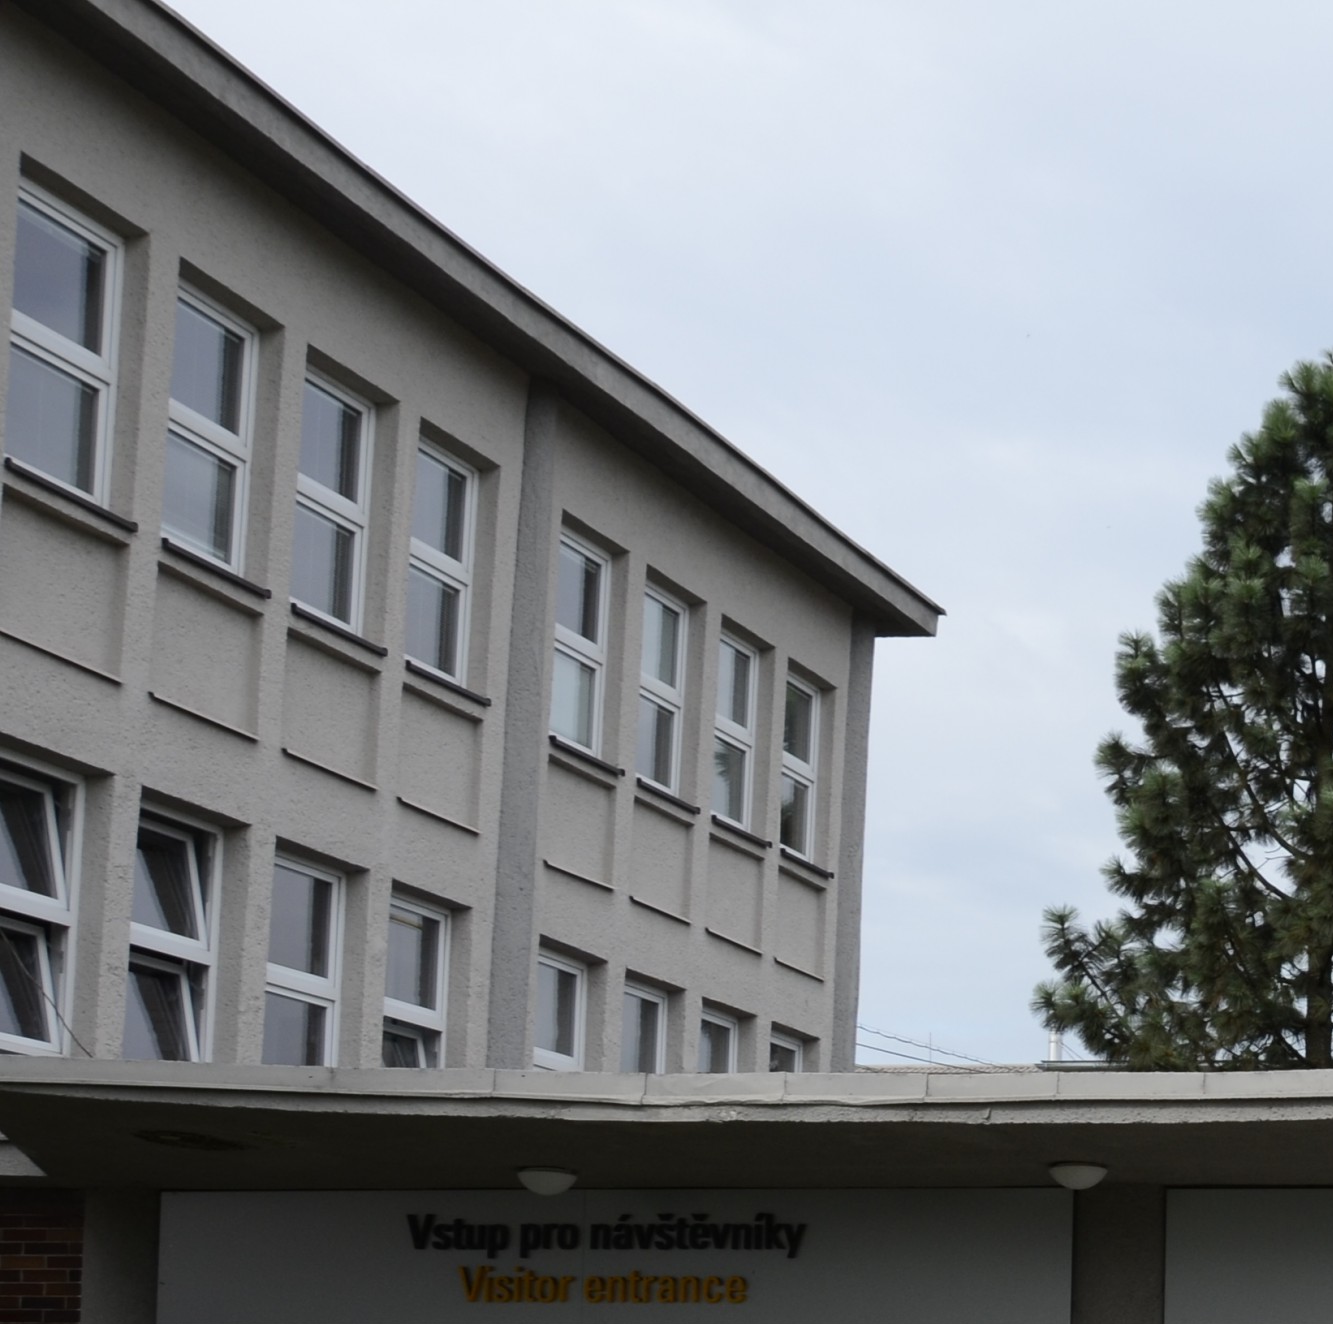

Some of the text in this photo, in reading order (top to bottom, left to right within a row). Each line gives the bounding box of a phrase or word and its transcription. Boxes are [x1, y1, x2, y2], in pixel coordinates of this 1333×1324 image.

[406, 1212, 808, 1259] Vstup pro návštěvníky
[457, 1264, 748, 1304] Visitor entrance
